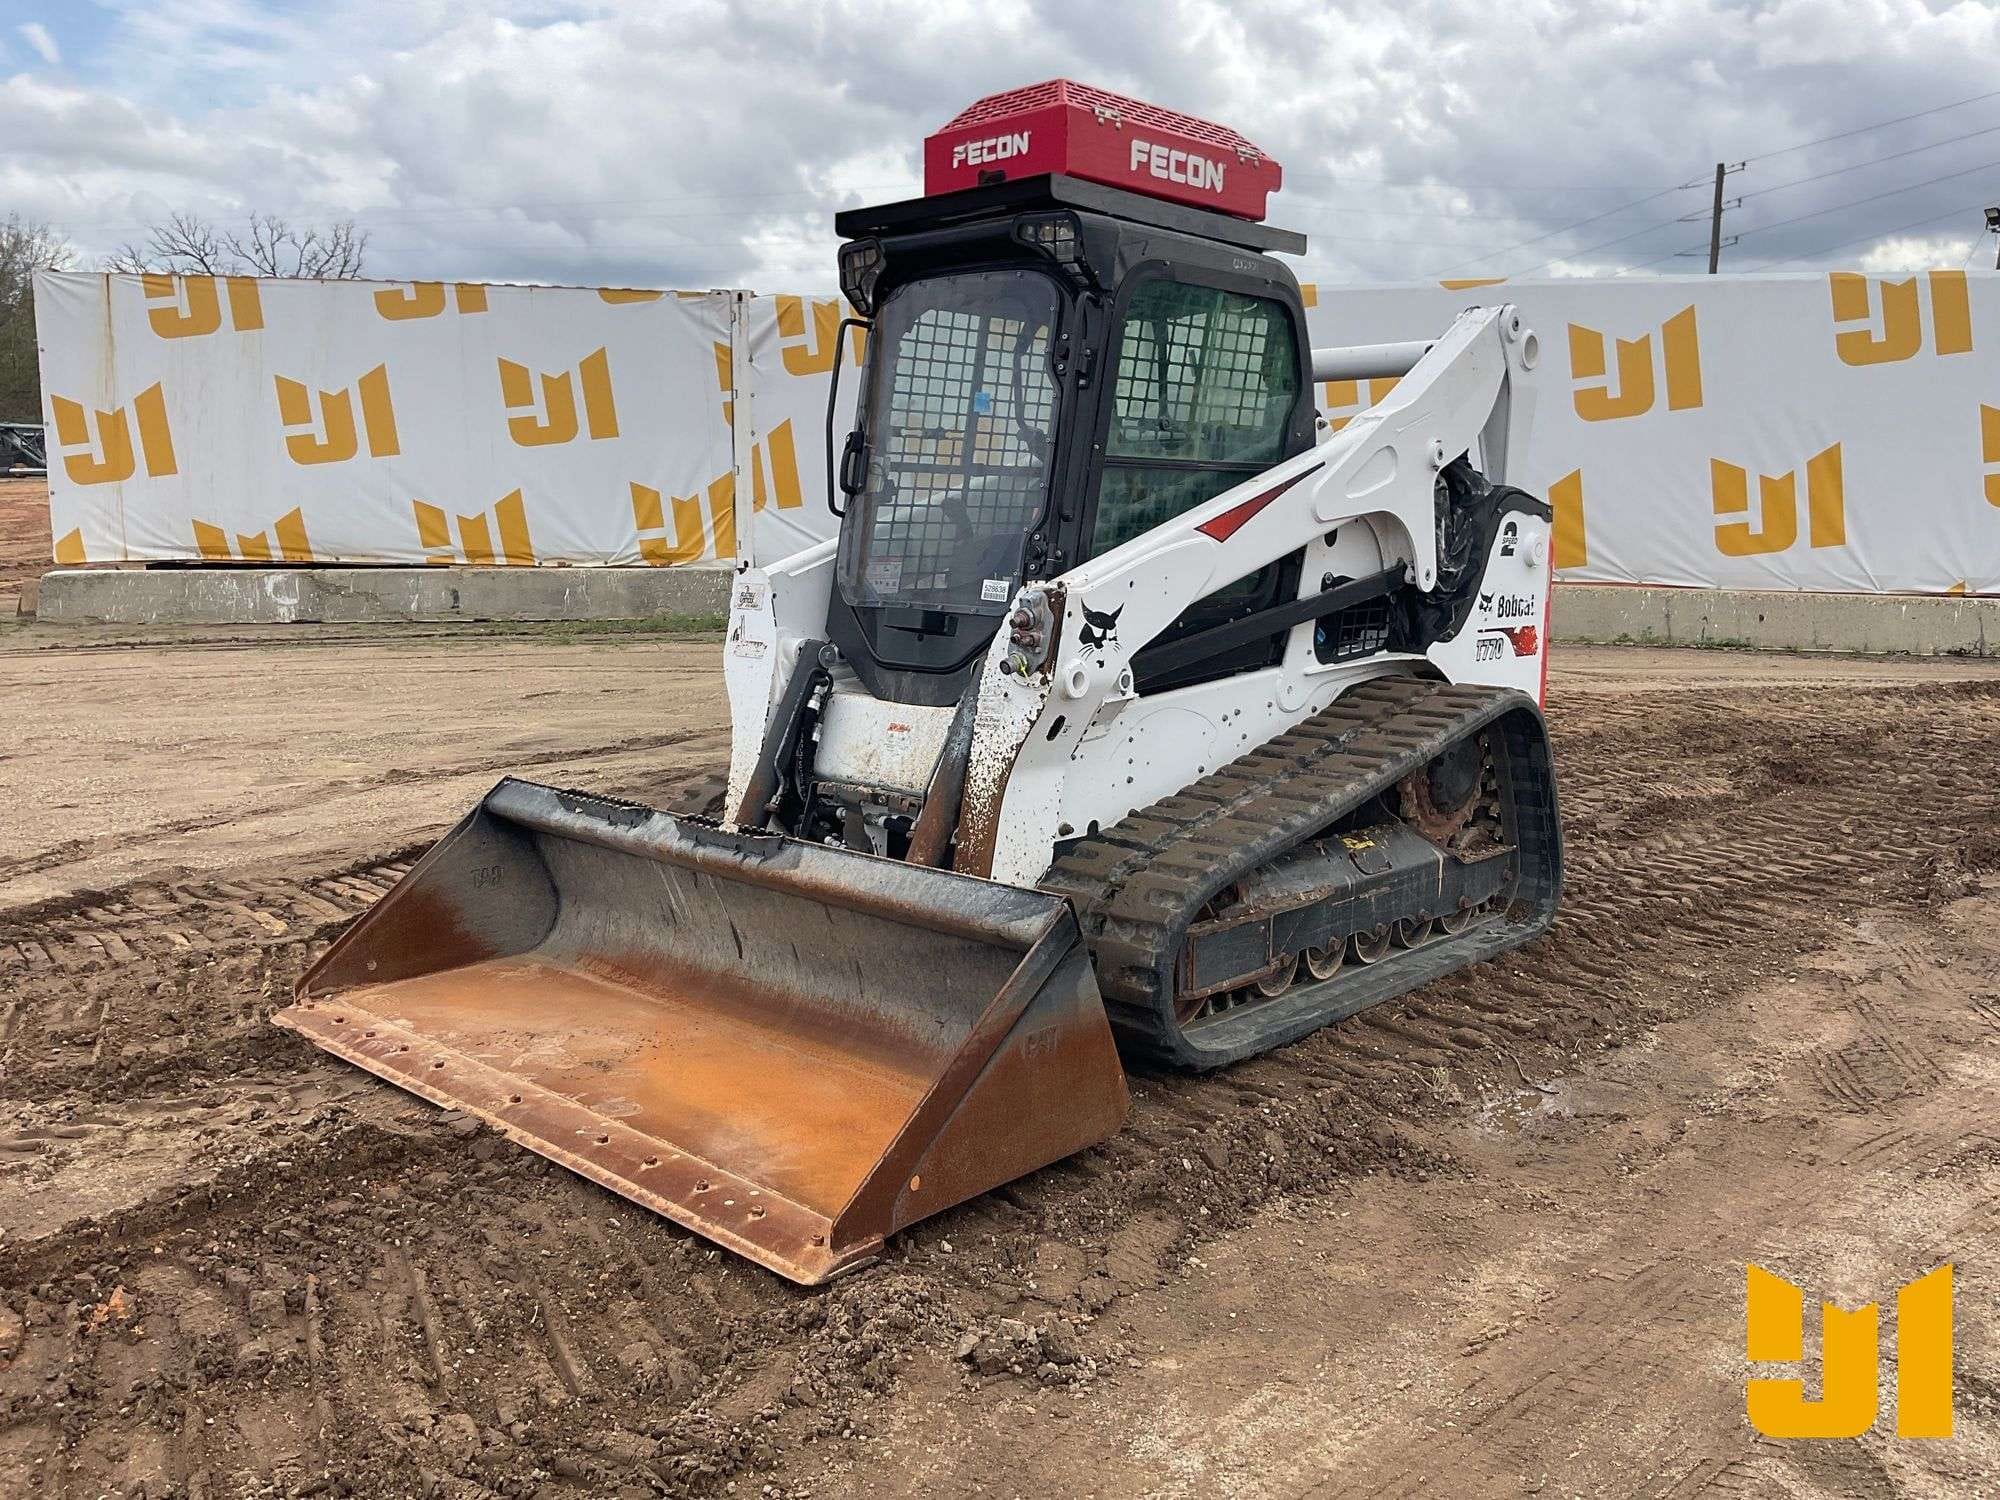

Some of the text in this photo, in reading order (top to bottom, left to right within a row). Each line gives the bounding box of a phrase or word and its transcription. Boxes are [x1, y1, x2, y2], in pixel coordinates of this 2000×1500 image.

[952, 131, 1030, 169] FECON
[1130, 139, 1224, 193] FECON
[1497, 594, 1534, 618] Bobcat
[1476, 638, 1504, 662] T770
